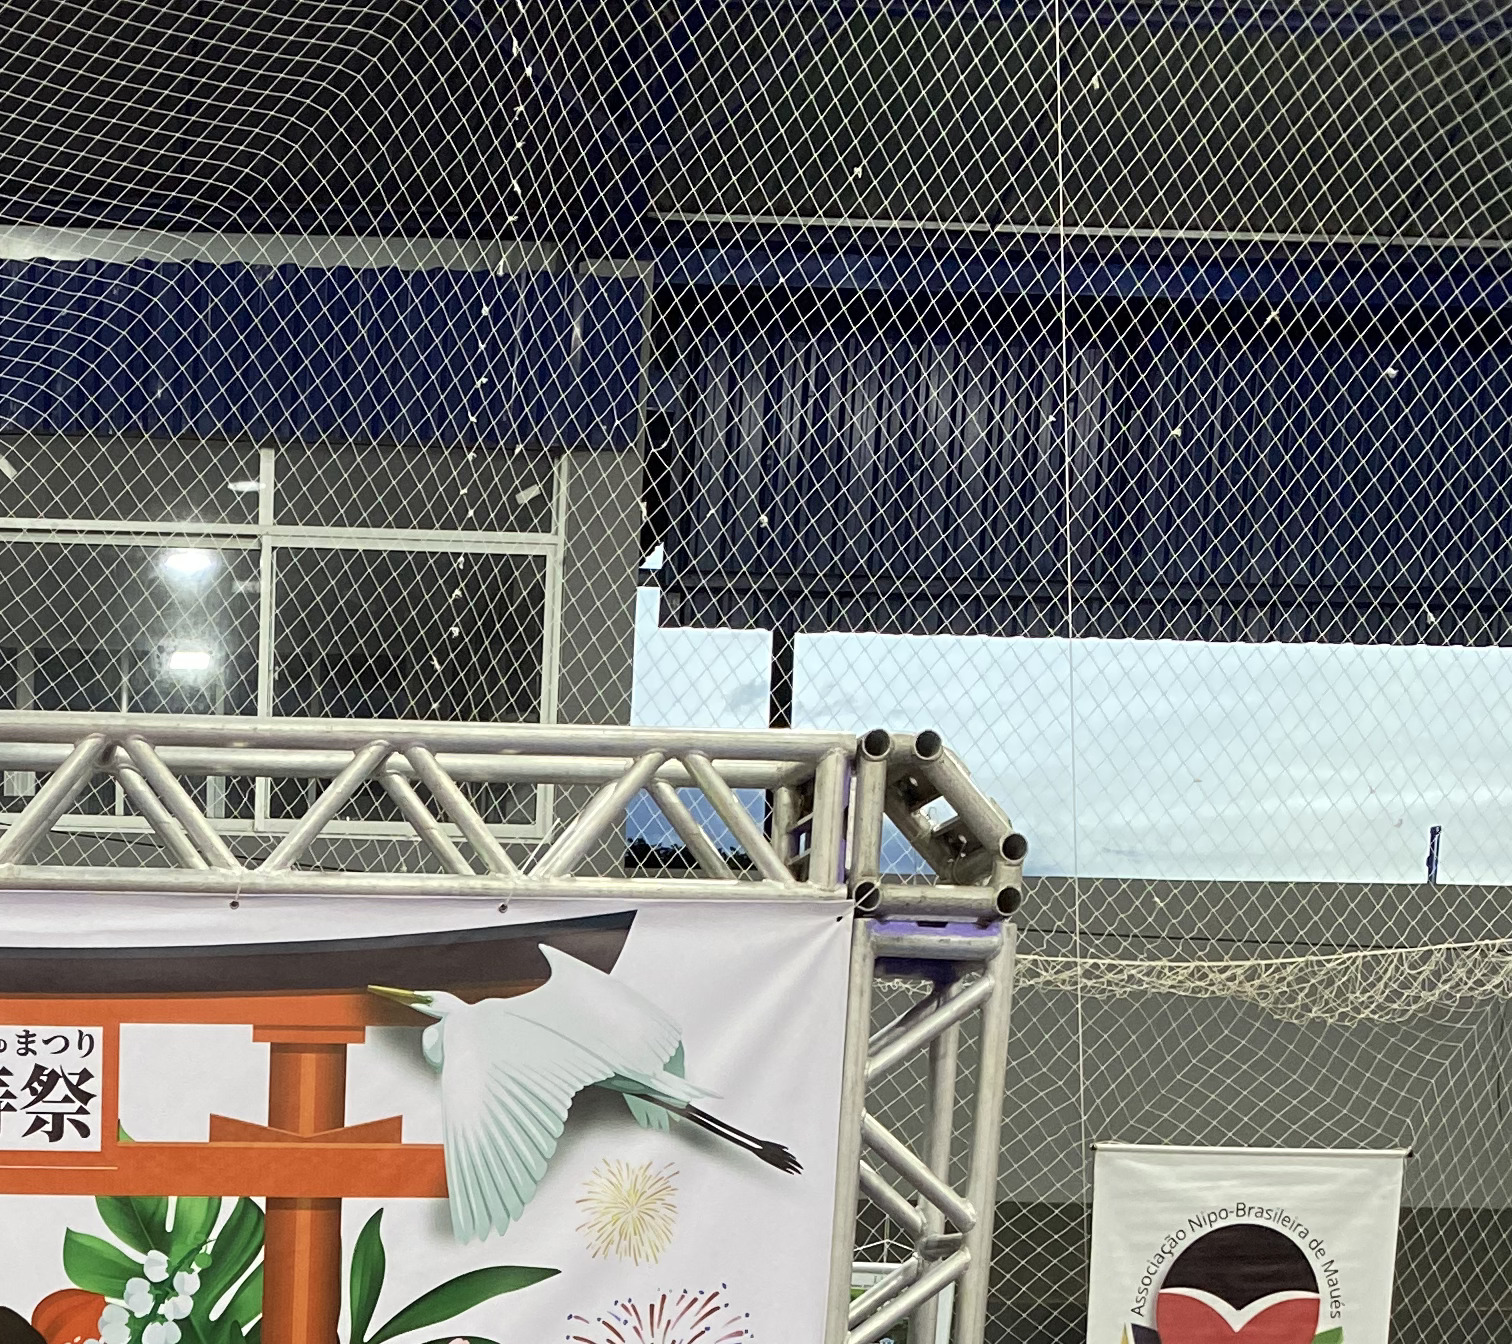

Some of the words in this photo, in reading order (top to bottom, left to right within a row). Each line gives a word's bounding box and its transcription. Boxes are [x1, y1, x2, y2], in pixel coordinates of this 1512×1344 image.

[1130, 1228, 1187, 1318] Associação
[1187, 1201, 1310, 1241] Nipo-Brasileira
[1308, 1237, 1326, 1260] de
[1321, 1259, 1347, 1320] Maués
